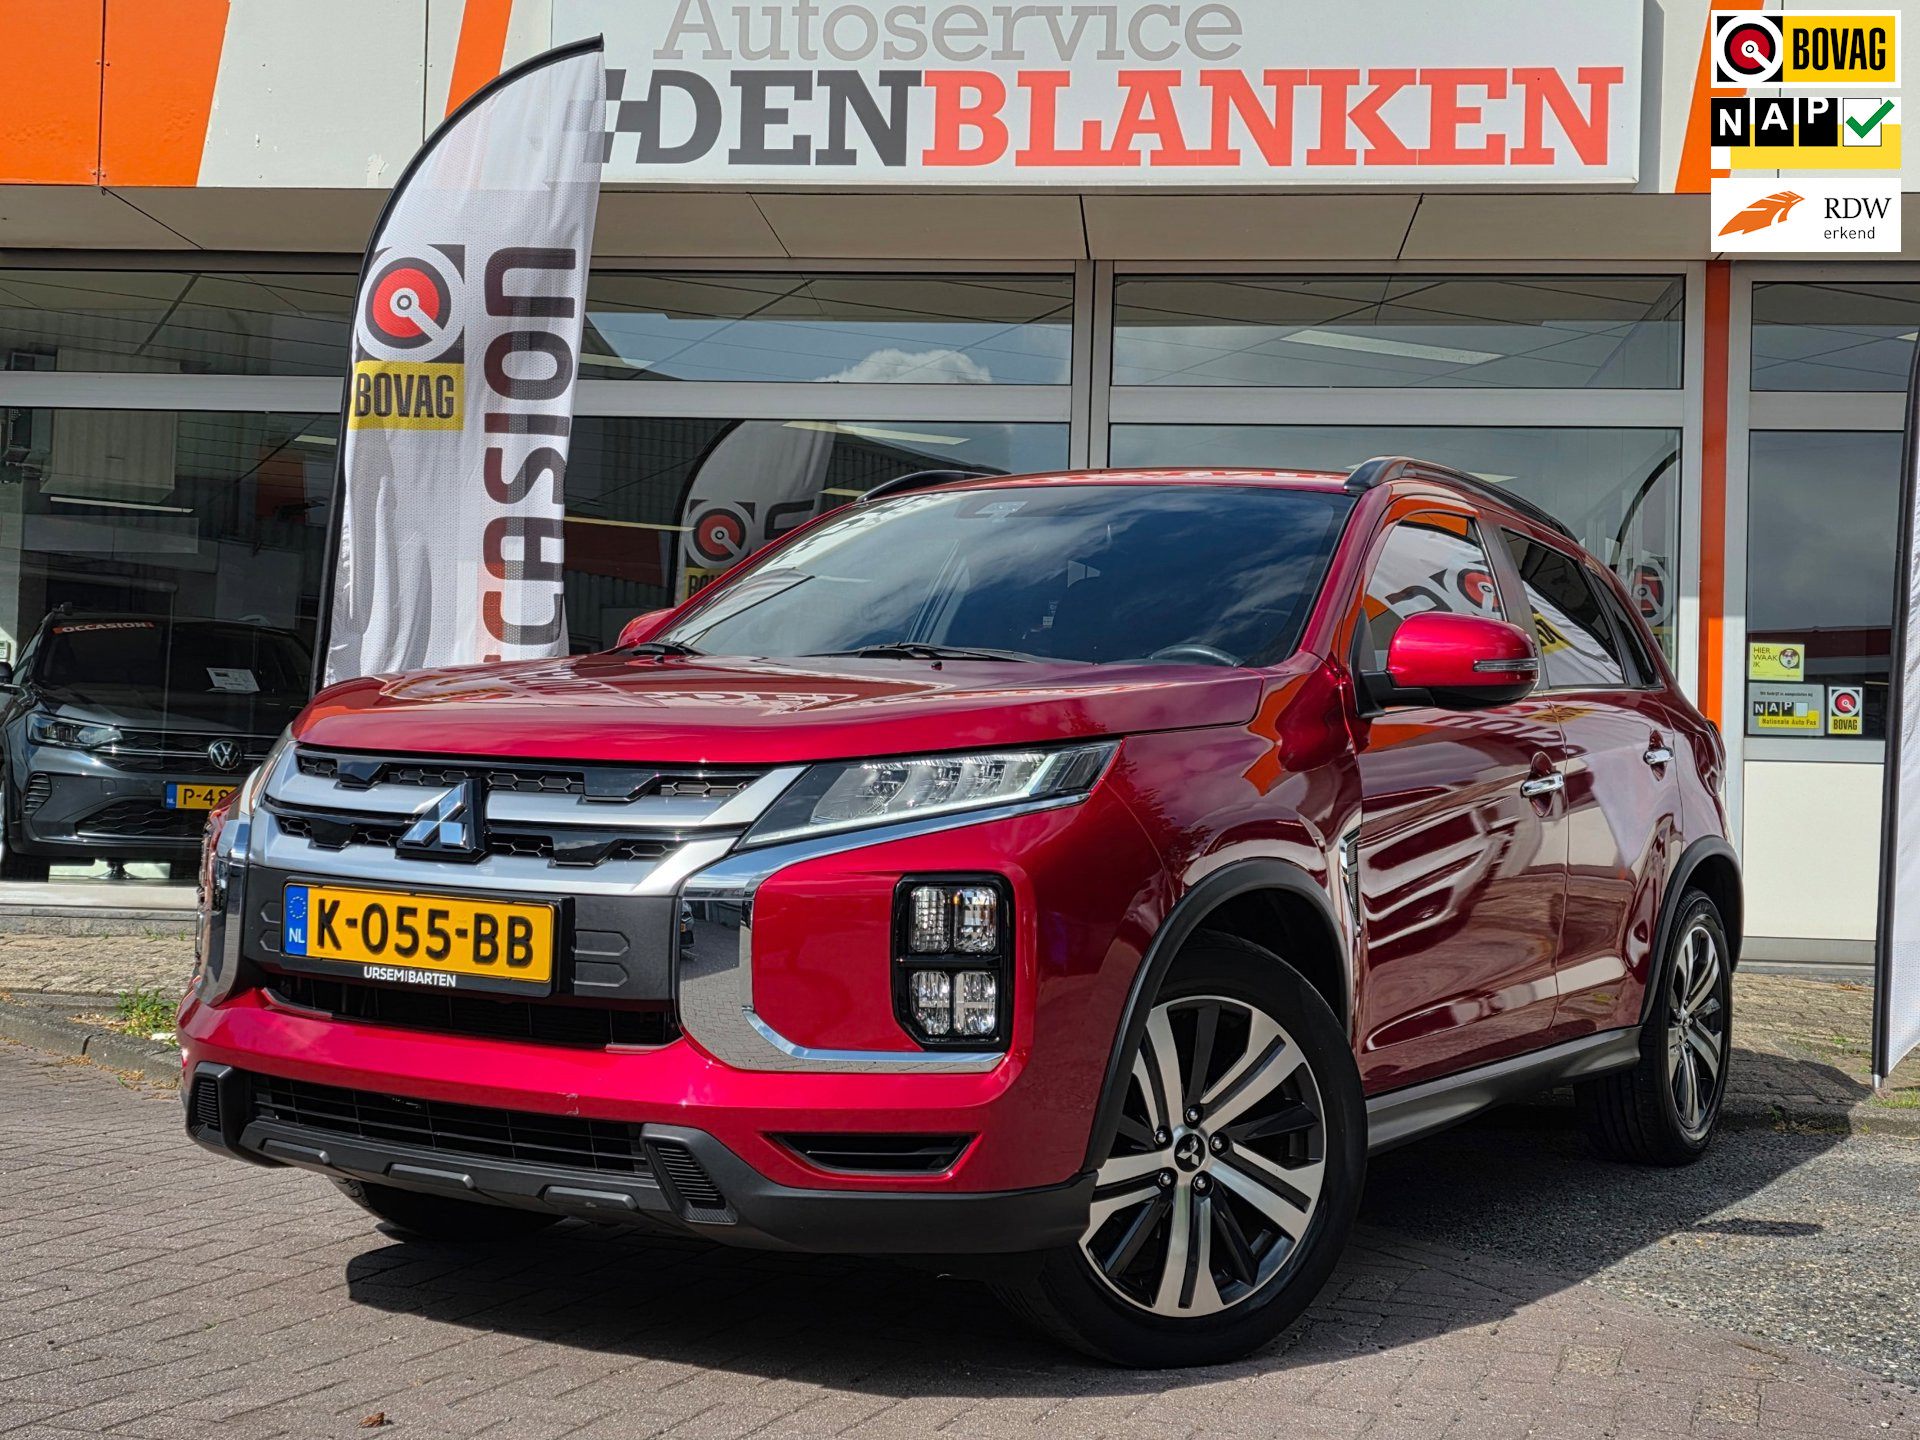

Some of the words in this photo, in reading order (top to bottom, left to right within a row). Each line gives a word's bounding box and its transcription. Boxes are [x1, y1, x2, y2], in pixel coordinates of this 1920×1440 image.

[652, 0, 1243, 62] Autoservice
[354, 372, 455, 419] BOVAG
[482, 246, 577, 662] CASION
[1753, 646, 1771, 654] HIER
[1755, 702, 1793, 714] NAP
[1833, 718, 1858, 730] BOVAG
[288, 927, 305, 944] NL
[316, 898, 534, 968] K-055-BB
